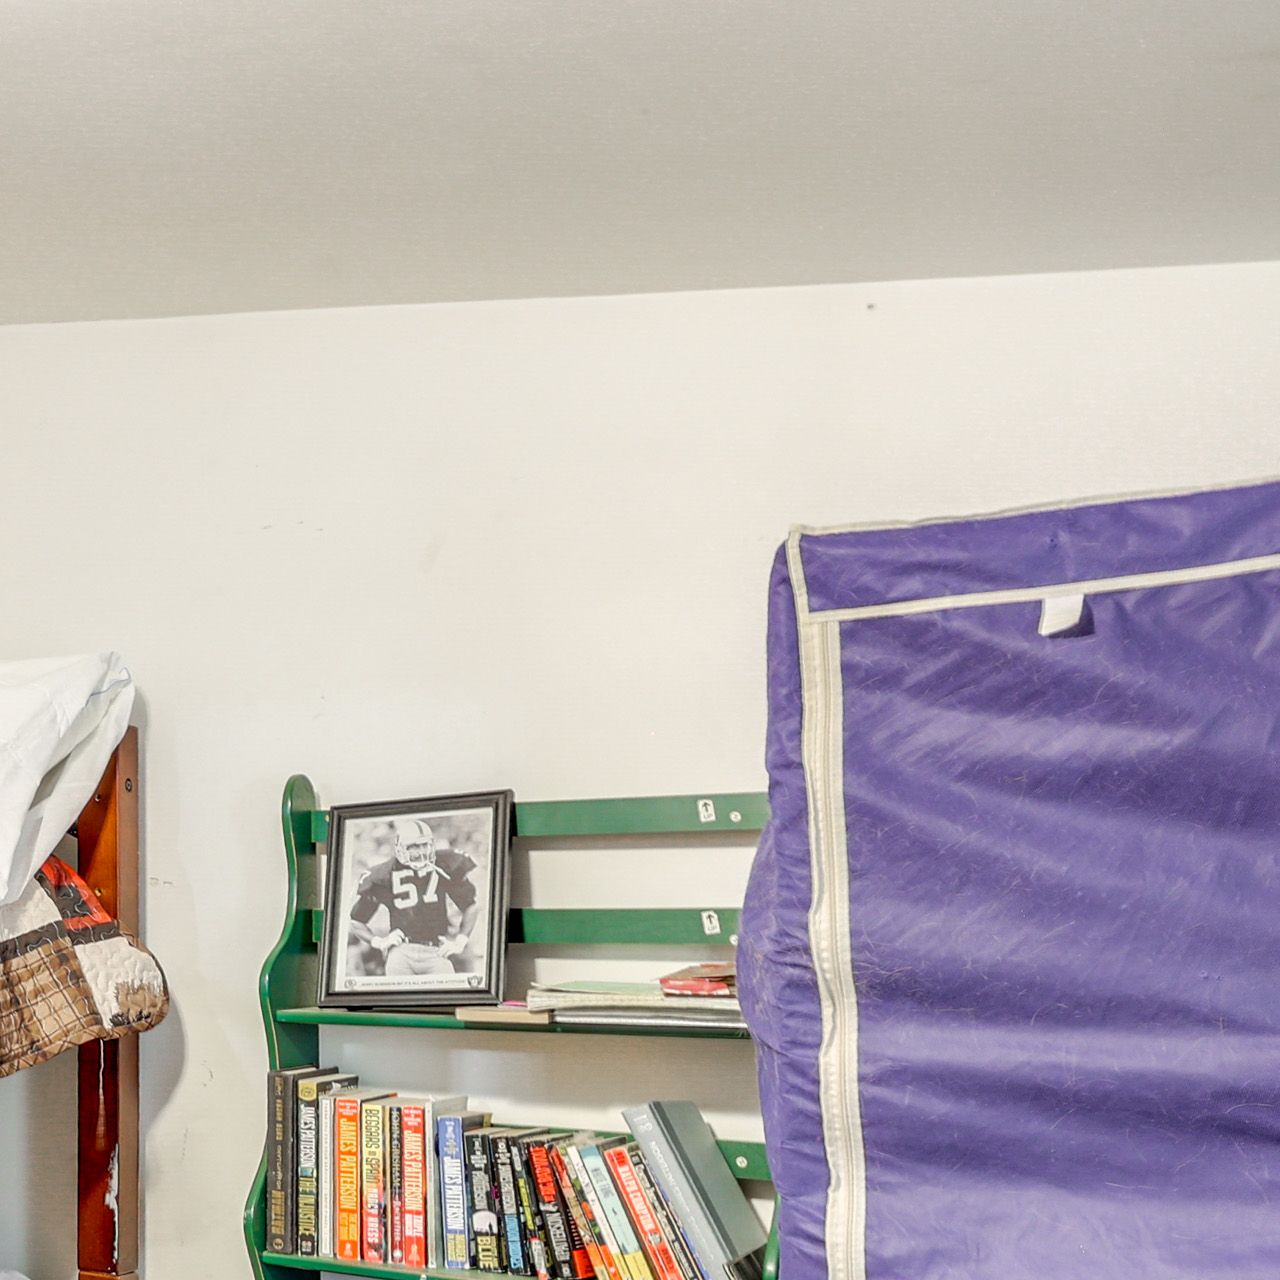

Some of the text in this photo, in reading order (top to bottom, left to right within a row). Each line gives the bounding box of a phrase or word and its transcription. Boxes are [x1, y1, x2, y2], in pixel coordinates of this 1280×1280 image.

[391, 866, 440, 909] 57
[300, 1105, 315, 1168] JAMES PATTERSON
[340, 1118, 356, 1152] JAMES
[366, 1109, 380, 1148] BEGGARS
[392, 1110, 401, 1187] JOHN GRISHAM
[404, 1130, 422, 1161] JAMES
[340, 1155, 357, 1209] PATTERSON
[366, 1158, 380, 1183] SPAIN
[404, 1161, 423, 1211] PATTERSON
[444, 1156, 462, 1185] JAMES
[472, 1170, 489, 1210] PATTERSON
[299, 1178, 315, 1236] THE INJUSTICE
[368, 1188, 379, 1243] NANCY KRESS
[445, 1185, 464, 1230] PATTERSON
[618, 1164, 639, 1194] RALPH
[629, 1190, 657, 1233] COMPTON
[477, 1235, 493, 1269] BLUE
